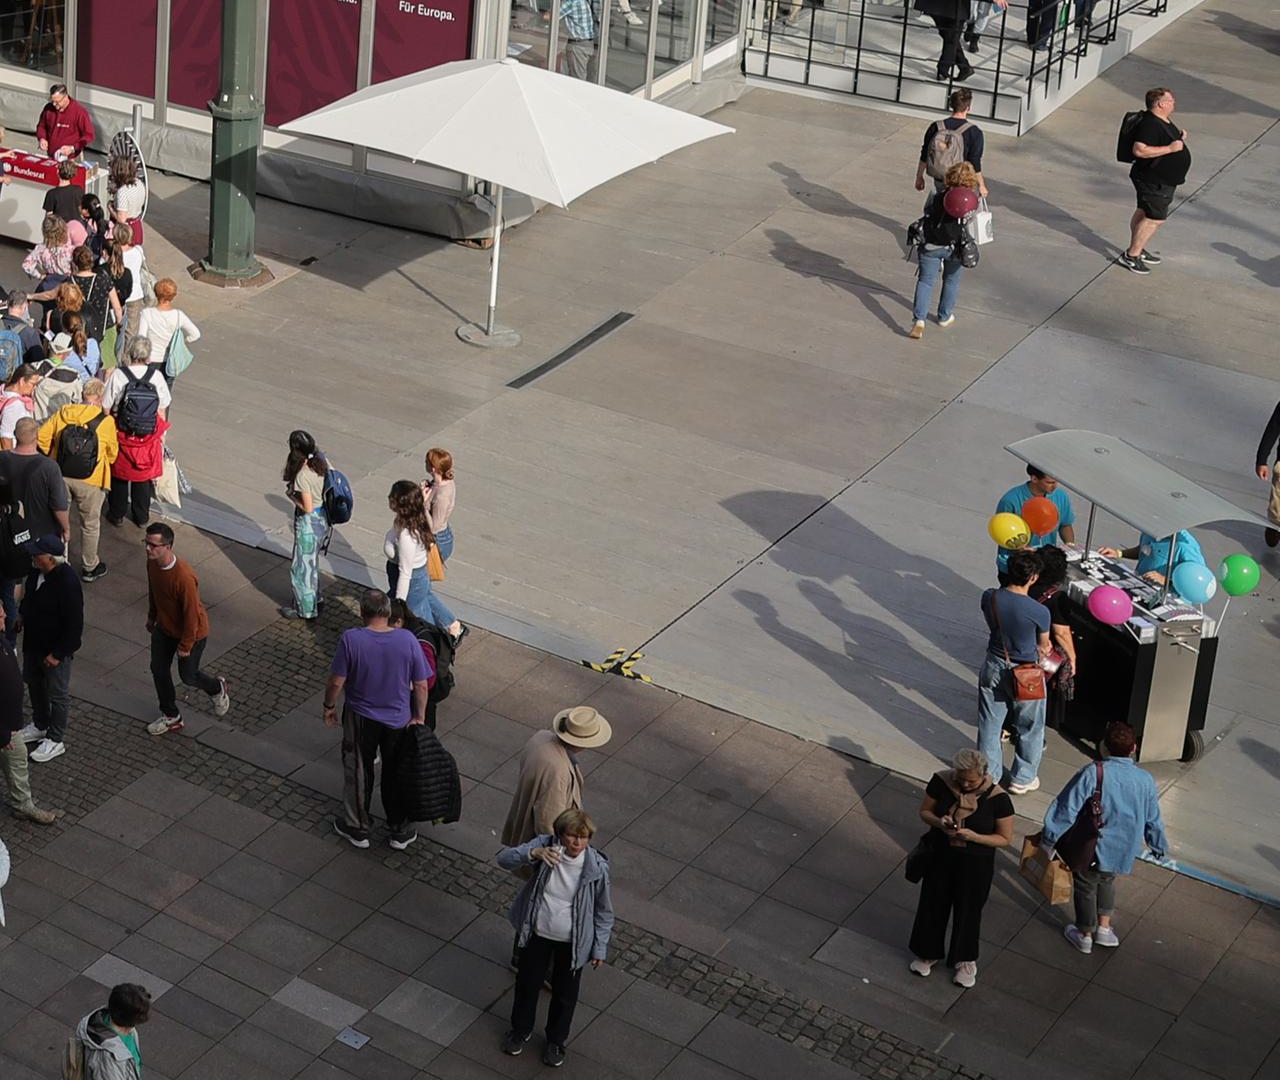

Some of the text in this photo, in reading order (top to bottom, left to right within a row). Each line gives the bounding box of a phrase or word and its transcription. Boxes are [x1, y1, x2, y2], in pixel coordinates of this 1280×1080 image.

[399, 0, 456, 21] Für Europa.
[13, 165, 45, 180] Bundesrat
[13, 529, 31, 545] VANS
